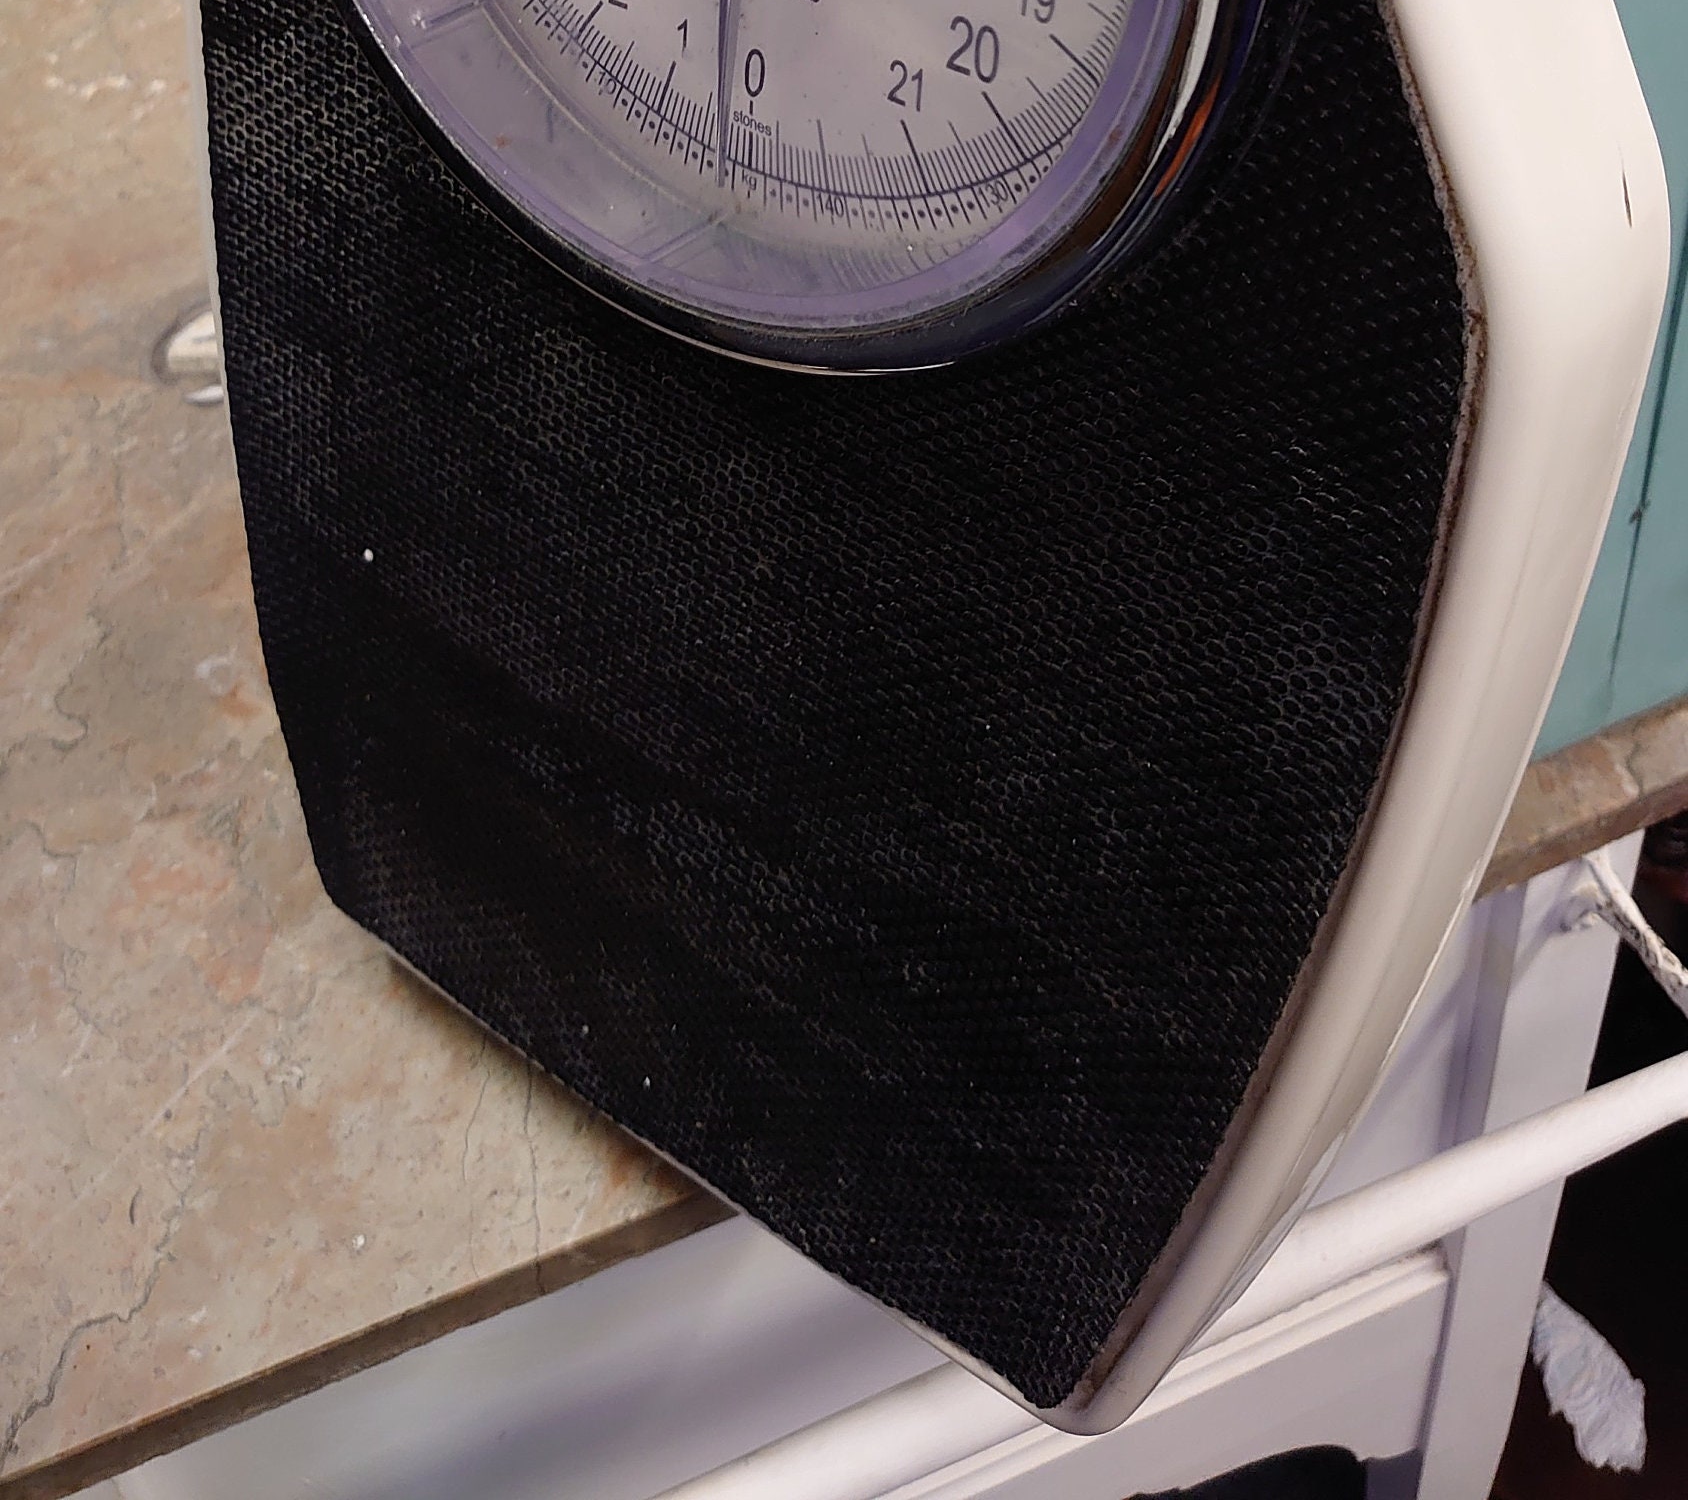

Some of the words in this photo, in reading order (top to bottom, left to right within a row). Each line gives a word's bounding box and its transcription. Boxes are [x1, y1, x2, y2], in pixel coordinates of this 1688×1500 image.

[677, 18, 688, 49] 1
[946, 16, 1000, 84] 20
[744, 48, 766, 98] 0
[887, 60, 924, 112] 21
[733, 109, 772, 137] stones
[741, 169, 758, 191] kg
[978, 179, 1009, 208] 130
[816, 190, 845, 218] 140
